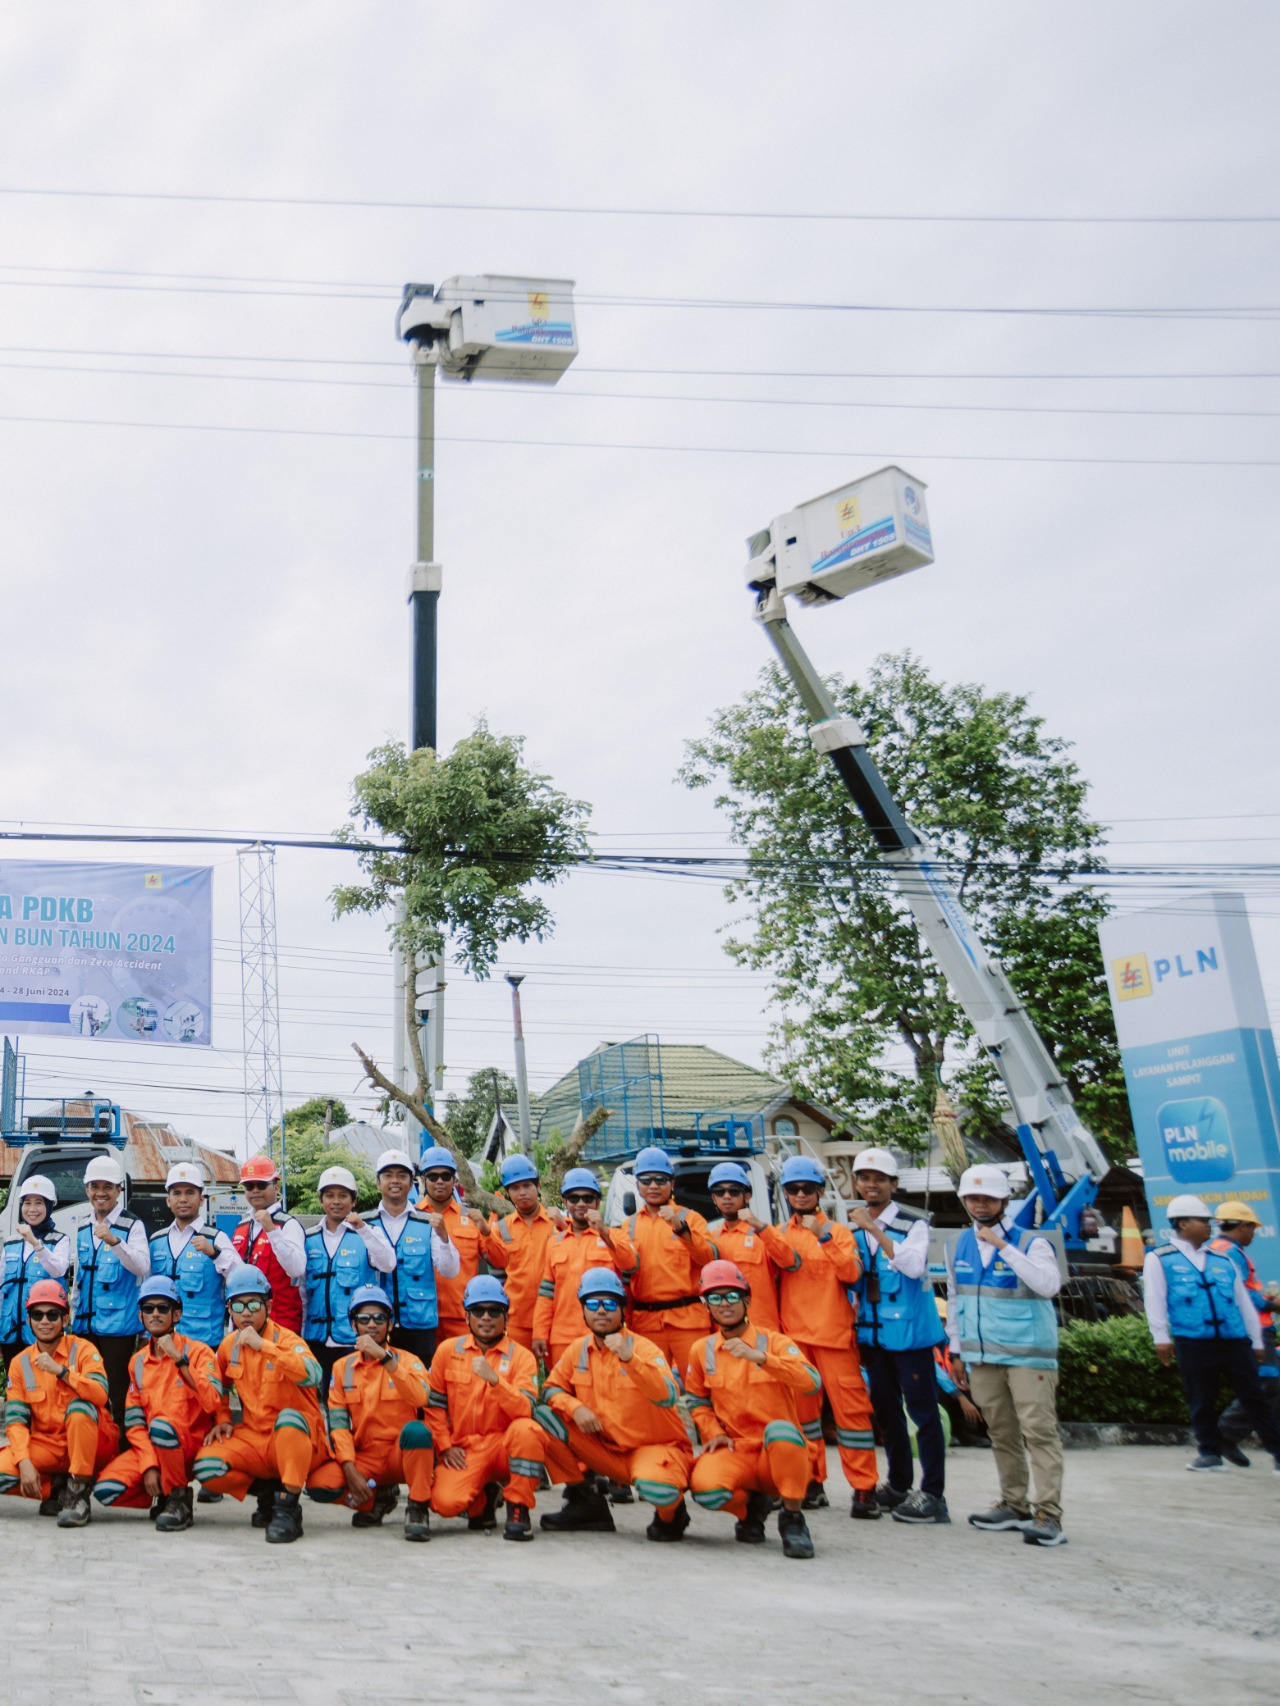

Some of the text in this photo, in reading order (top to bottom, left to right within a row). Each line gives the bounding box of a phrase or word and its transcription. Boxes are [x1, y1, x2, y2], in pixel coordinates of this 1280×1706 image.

[849, 543, 871, 557] DHT
[872, 532, 897, 548] 150S
[22, 895, 94, 923] PDKB
[14, 927, 53, 946] BUN
[59, 929, 121, 950] TAHUN
[126, 932, 176, 954] 2024
[11, 954, 65, 967] Gangguan
[67, 956, 88, 966] dan
[89, 957, 114, 968] Zero
[116, 959, 163, 971] Accident
[1153, 946, 1219, 983] PLN
[13, 987, 24, 995] 28
[26, 987, 45, 997] Juni
[47, 988, 70, 997] 2024
[1166, 1045, 1190, 1057] UNIT
[1133, 1053, 1236, 1078] LAYANAN PELANGGAN
[1165, 1073, 1203, 1088] SAMPIT
[1163, 1124, 1199, 1144] PLN
[1168, 1141, 1229, 1163] mobile
[1225, 1190, 1268, 1202] MUDAH
